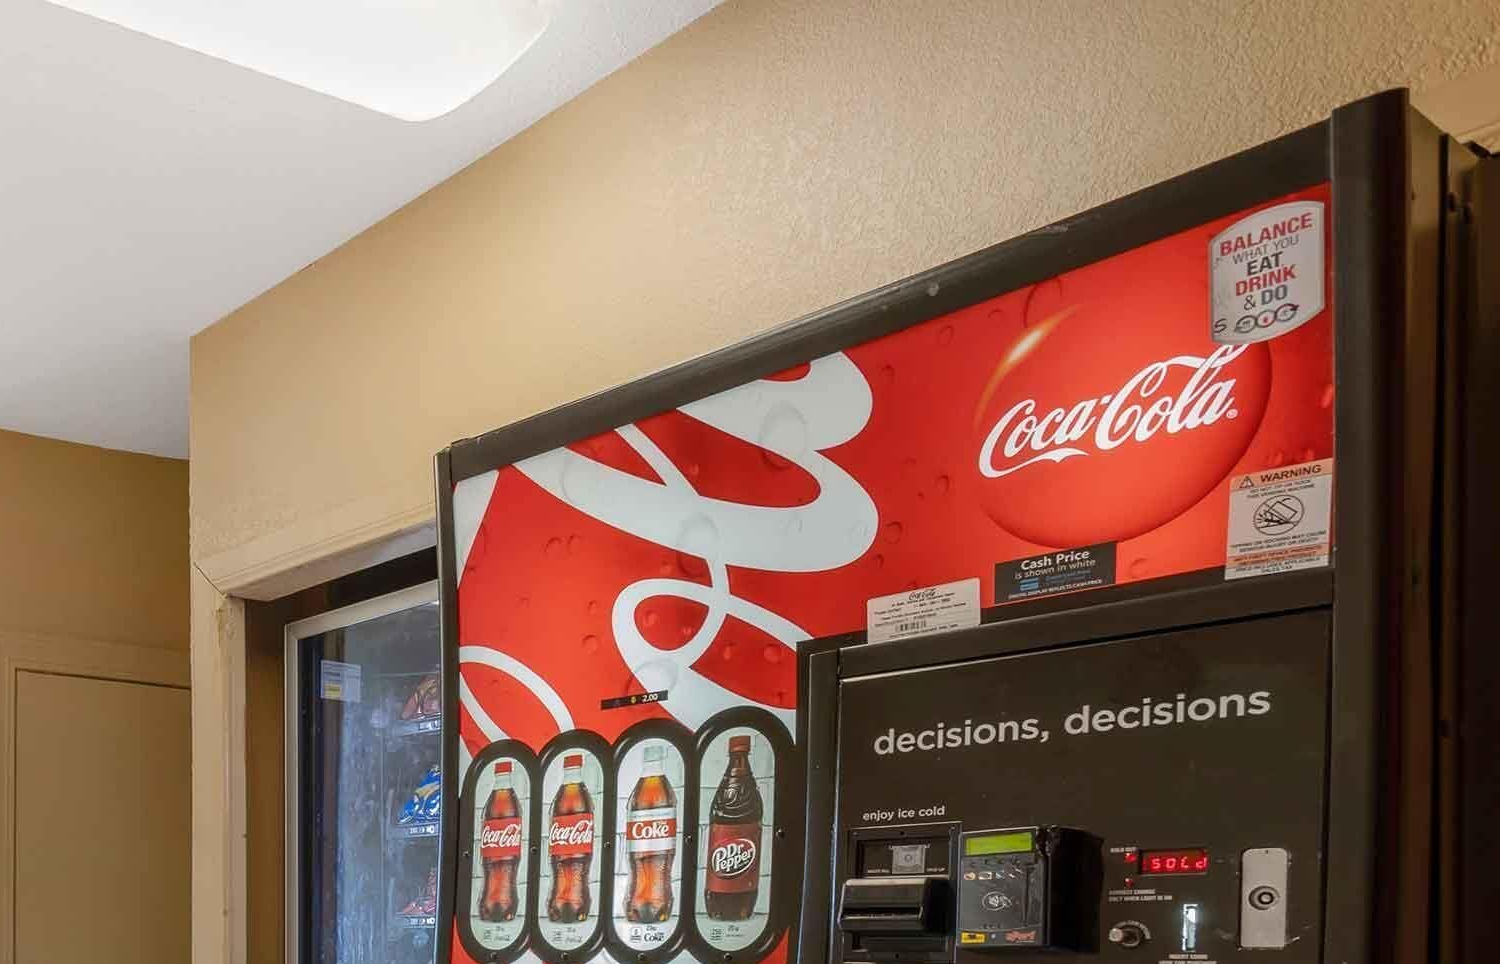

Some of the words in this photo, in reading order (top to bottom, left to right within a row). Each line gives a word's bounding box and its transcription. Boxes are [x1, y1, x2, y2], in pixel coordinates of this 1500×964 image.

[1220, 212, 1313, 256] BALANCE
[1232, 244, 1268, 264] WHAT
[1273, 234, 1300, 250] YOU
[1247, 251, 1283, 276] EAT
[1236, 264, 1297, 296] DRINK
[1244, 294, 1256, 311] &
[1261, 284, 1288, 305] DO
[978, 344, 1248, 478] Coca-Cola
[1260, 464, 1322, 482] WARNING
[1014, 572, 1022, 580] is
[1025, 566, 1055, 578] shown
[1057, 562, 1067, 572] in
[1069, 559, 1097, 570] white
[1021, 556, 1052, 571] Cash
[1056, 550, 1090, 564] Price
[642, 693, 659, 703] 2.00
[874, 718, 1050, 756] decisions,
[1063, 690, 1271, 735] decisions
[863, 809, 895, 821] enjoy
[898, 808, 915, 818] ice
[918, 805, 946, 817] cold
[481, 823, 521, 848] Coca-Cola
[548, 820, 593, 846] Coca-Cola
[631, 820, 670, 839] Coke
[713, 846, 755, 872] Pepper
[727, 842, 745, 857] Dr
